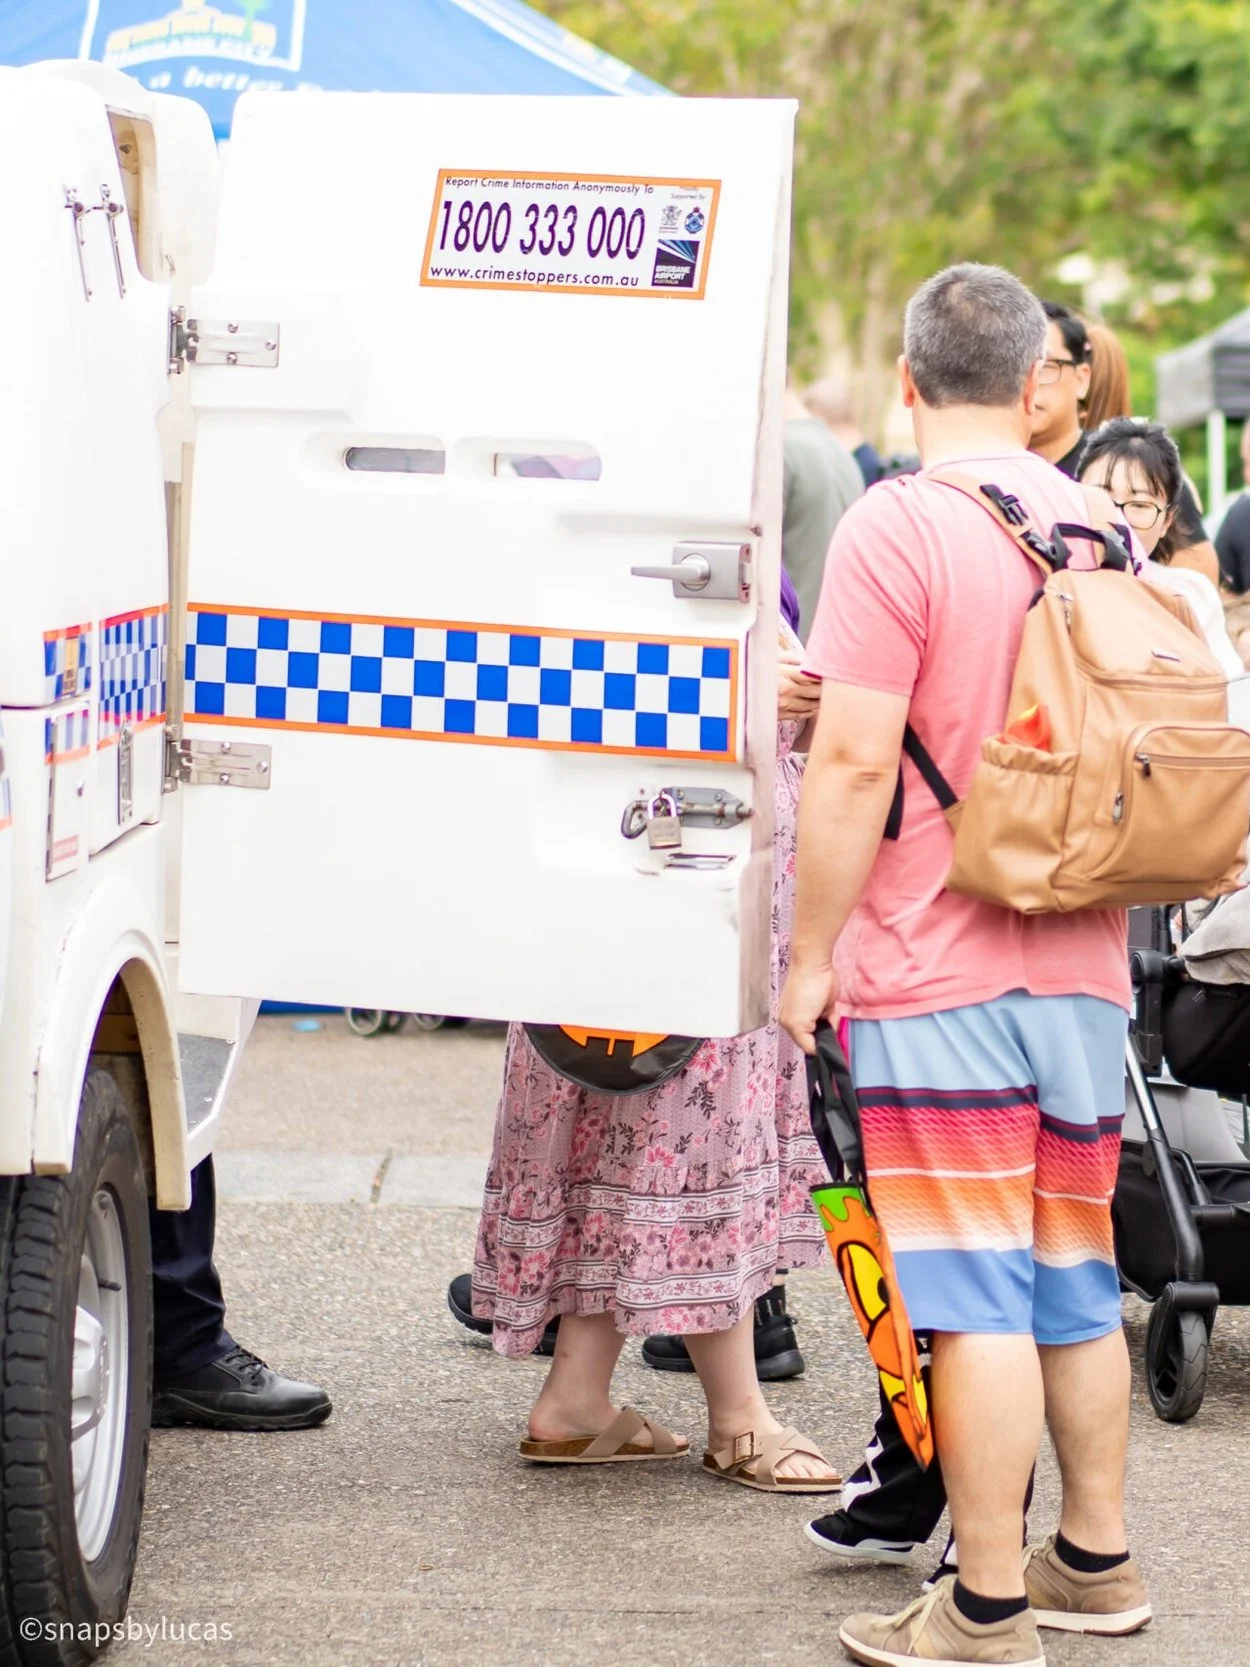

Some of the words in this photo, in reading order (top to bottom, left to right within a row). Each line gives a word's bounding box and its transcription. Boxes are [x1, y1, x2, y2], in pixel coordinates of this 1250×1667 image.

[445, 177, 478, 187] Report
[481, 178, 509, 189] Crime
[512, 179, 570, 191] Information
[572, 182, 641, 195] Anonymously
[644, 184, 654, 194] To
[440, 200, 512, 254] 1800
[519, 203, 578, 257] 333
[587, 206, 645, 260] 000
[430, 265, 639, 286] www.crimestoppers.com.au
